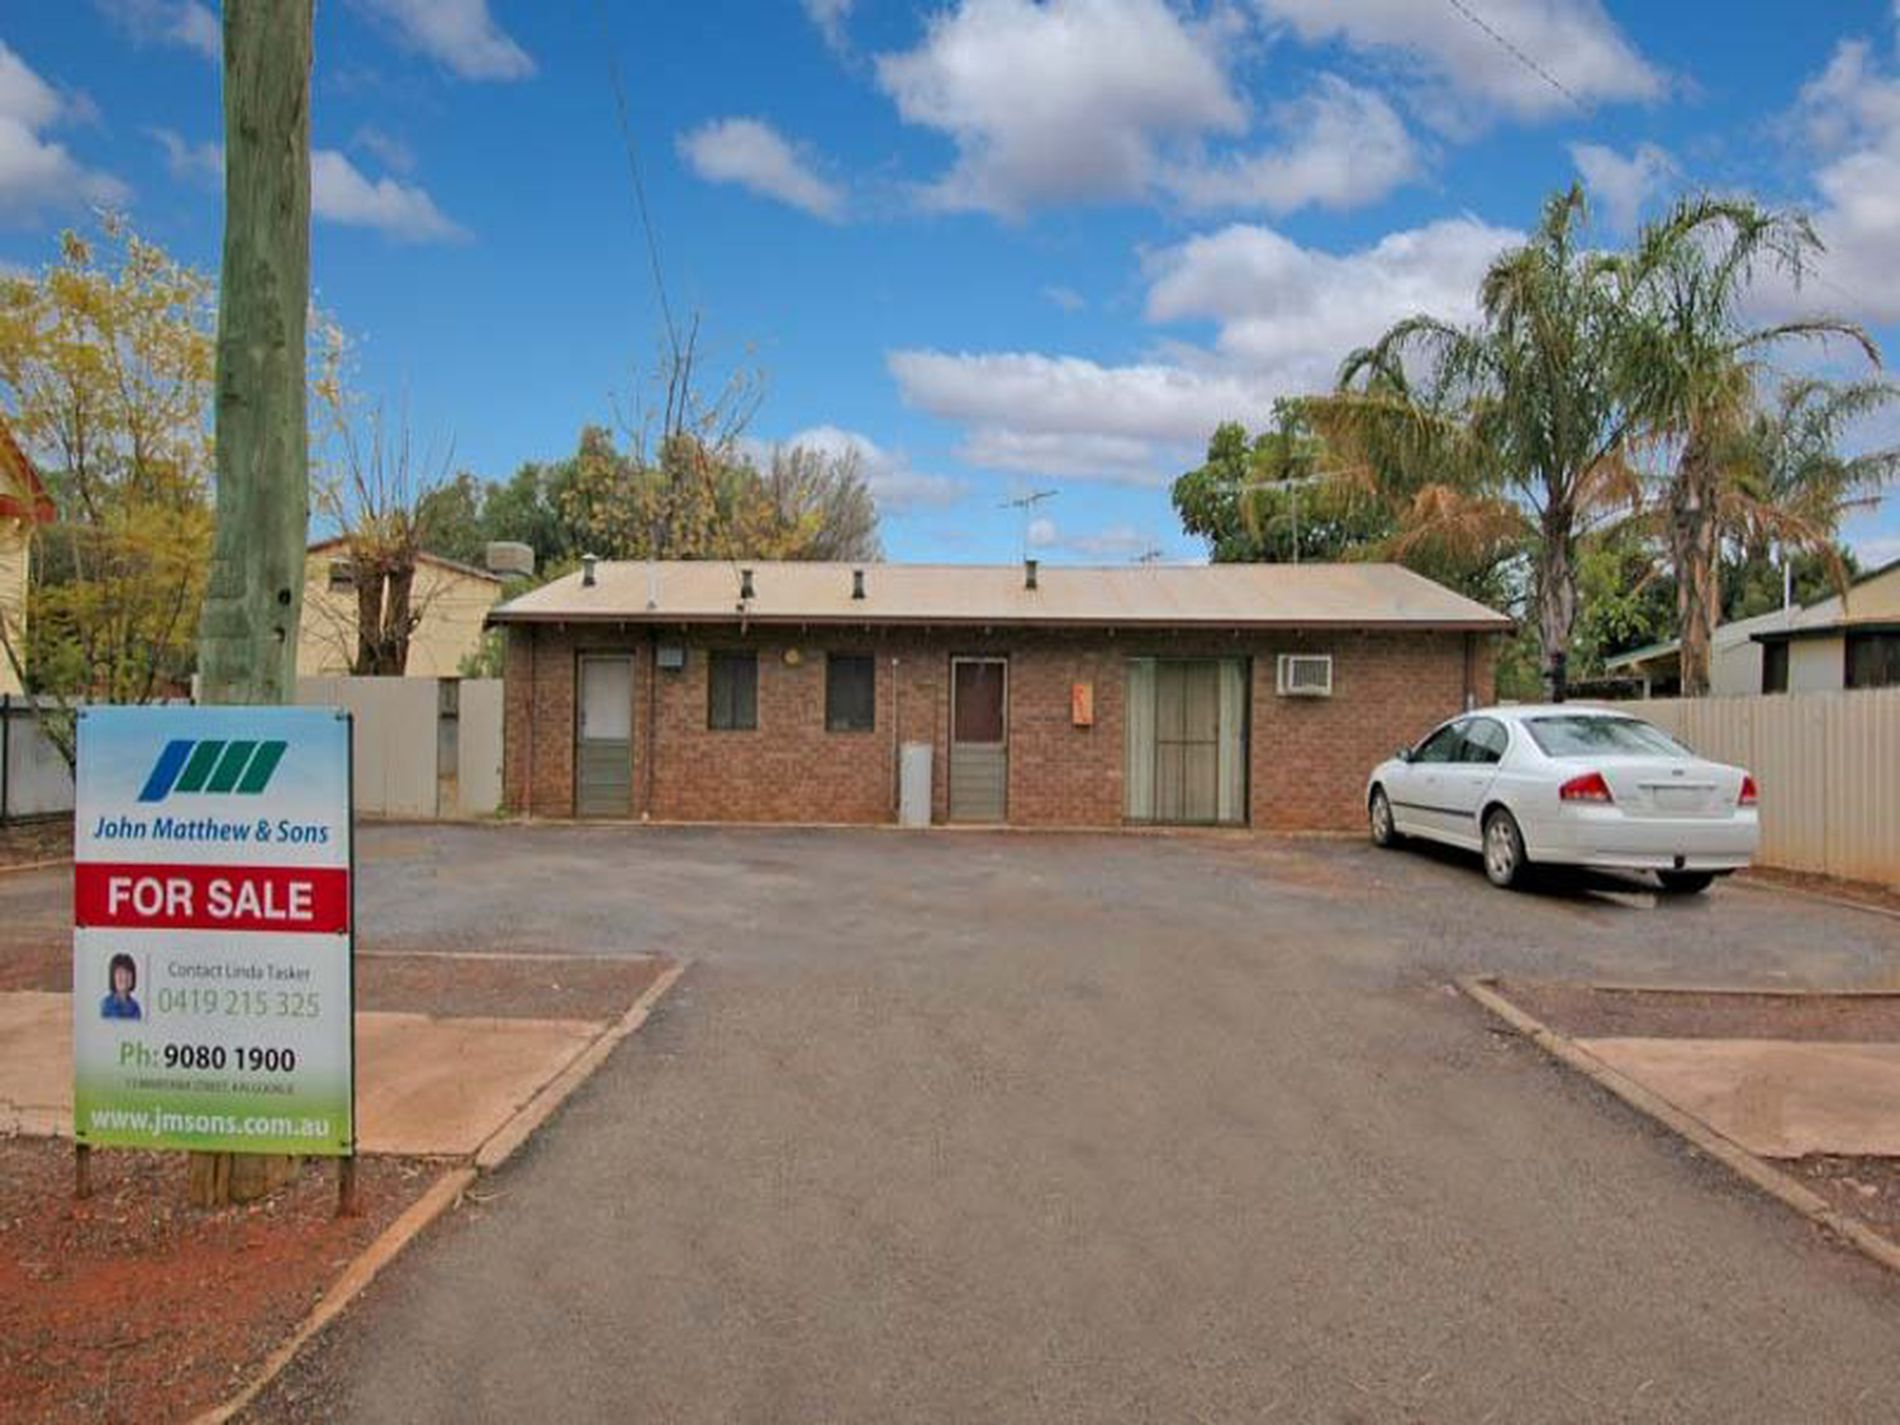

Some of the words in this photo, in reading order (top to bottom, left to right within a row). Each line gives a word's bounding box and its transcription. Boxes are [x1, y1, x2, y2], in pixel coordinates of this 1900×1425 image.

[94, 817, 147, 840] John
[152, 817, 251, 841] Matthew
[255, 820, 272, 842] &
[276, 820, 330, 843] Sons
[108, 877, 194, 916] FOR
[206, 879, 314, 920] SALE
[168, 961, 224, 979] Contact
[225, 963, 264, 980] Linda
[267, 966, 311, 982] Tasker
[158, 988, 218, 1014] 0419
[225, 990, 268, 1016] 215
[275, 993, 320, 1018] 325
[119, 1041, 158, 1067] Ph:
[164, 1044, 227, 1070] 9080
[236, 1048, 297, 1072] 1900
[91, 1106, 330, 1137] www.jmsons.com.au
